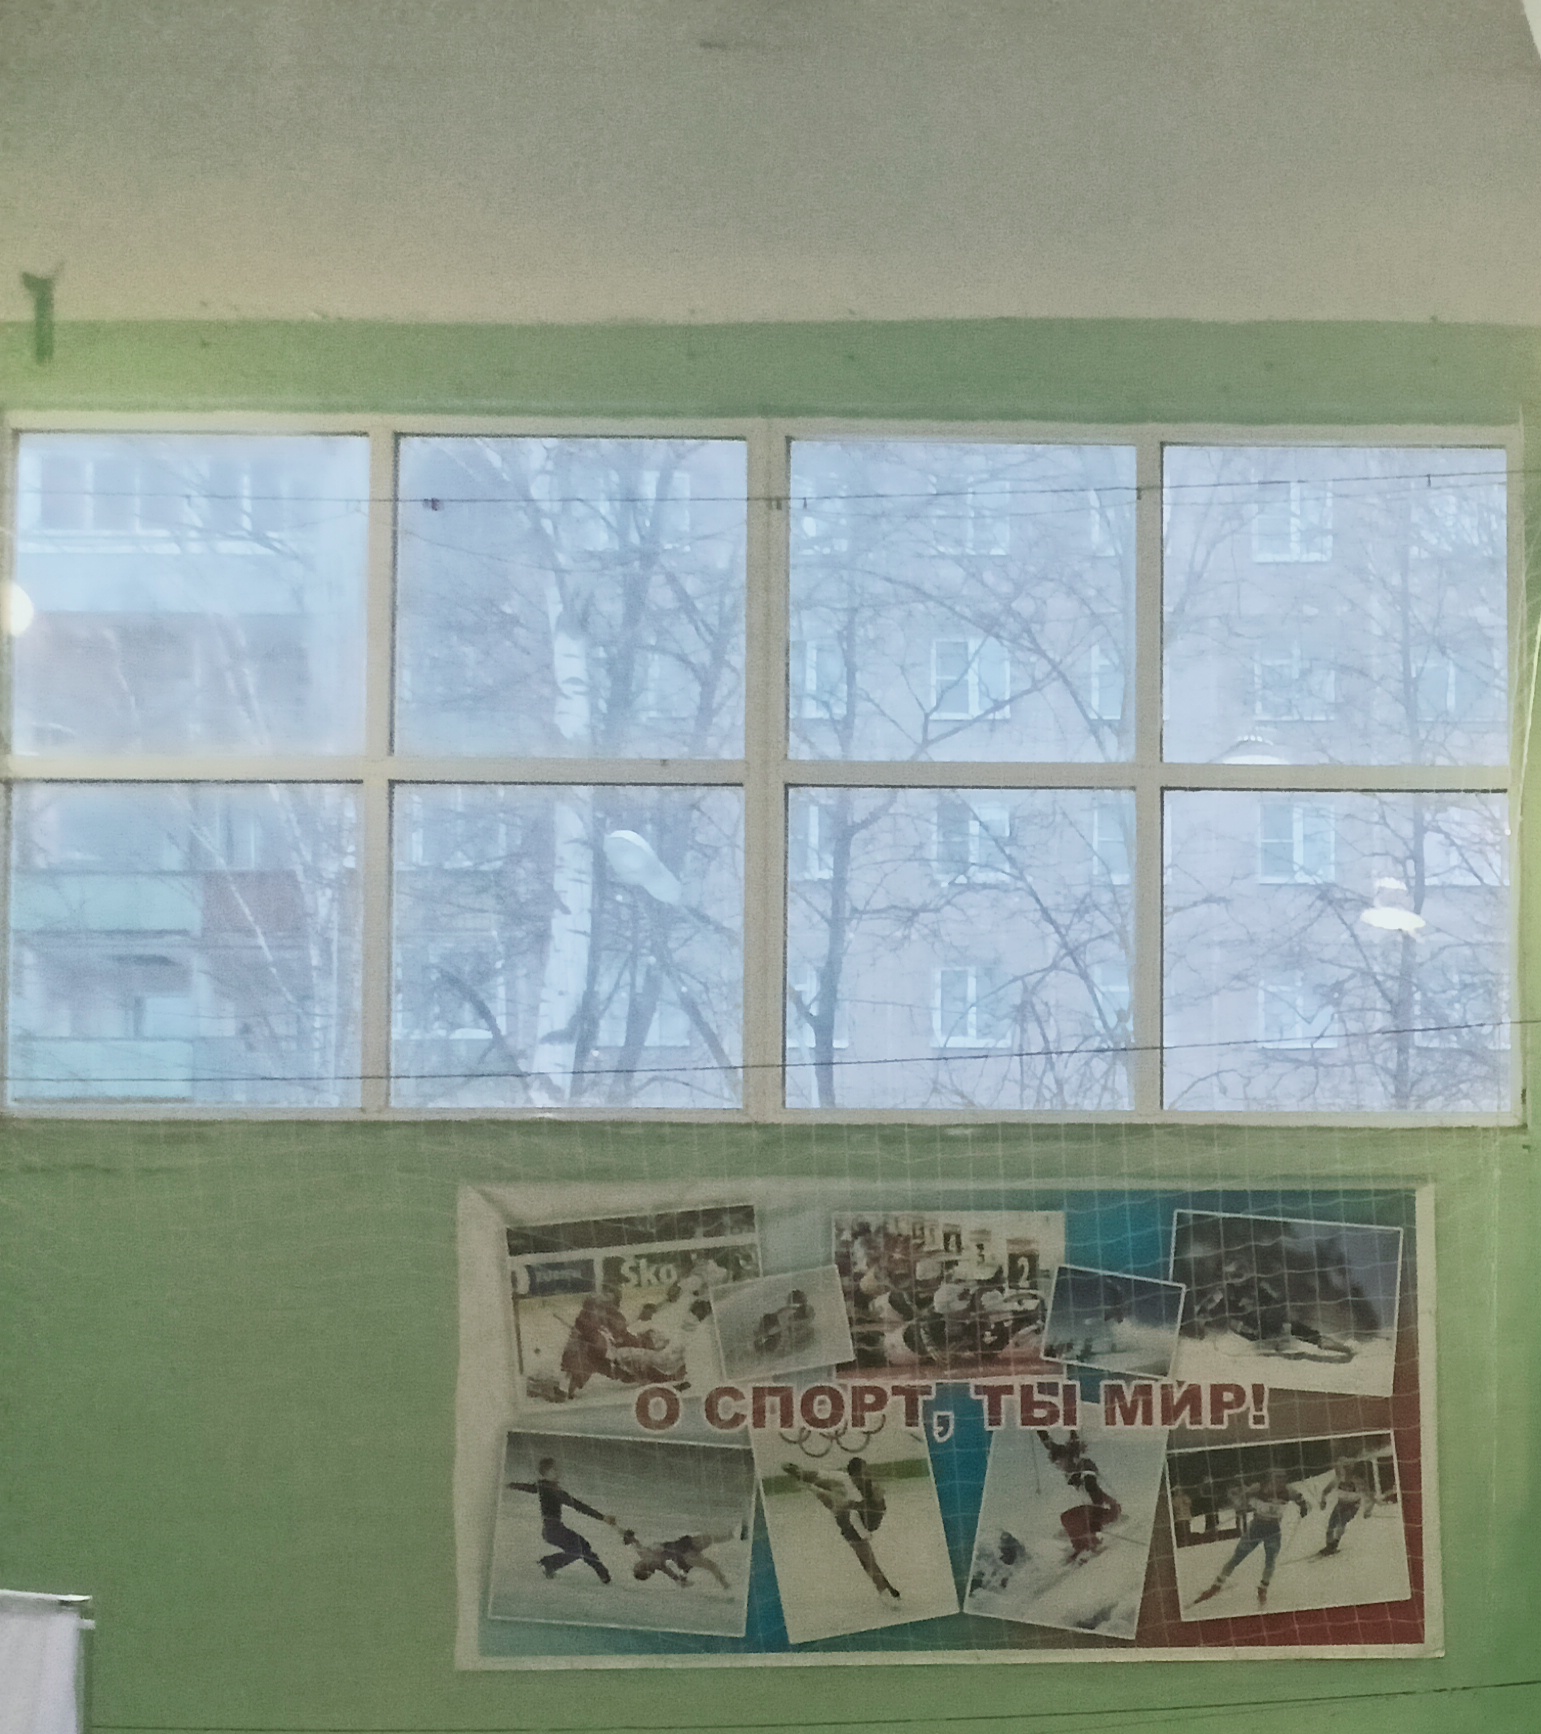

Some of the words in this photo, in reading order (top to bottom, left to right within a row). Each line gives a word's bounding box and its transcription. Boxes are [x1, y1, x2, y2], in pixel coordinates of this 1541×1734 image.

[635, 1385, 681, 1431] О
[703, 1382, 954, 1441] СПОРТ,
[972, 1381, 1079, 1429] ТЫ
[1101, 1380, 1269, 1428] МИР!
